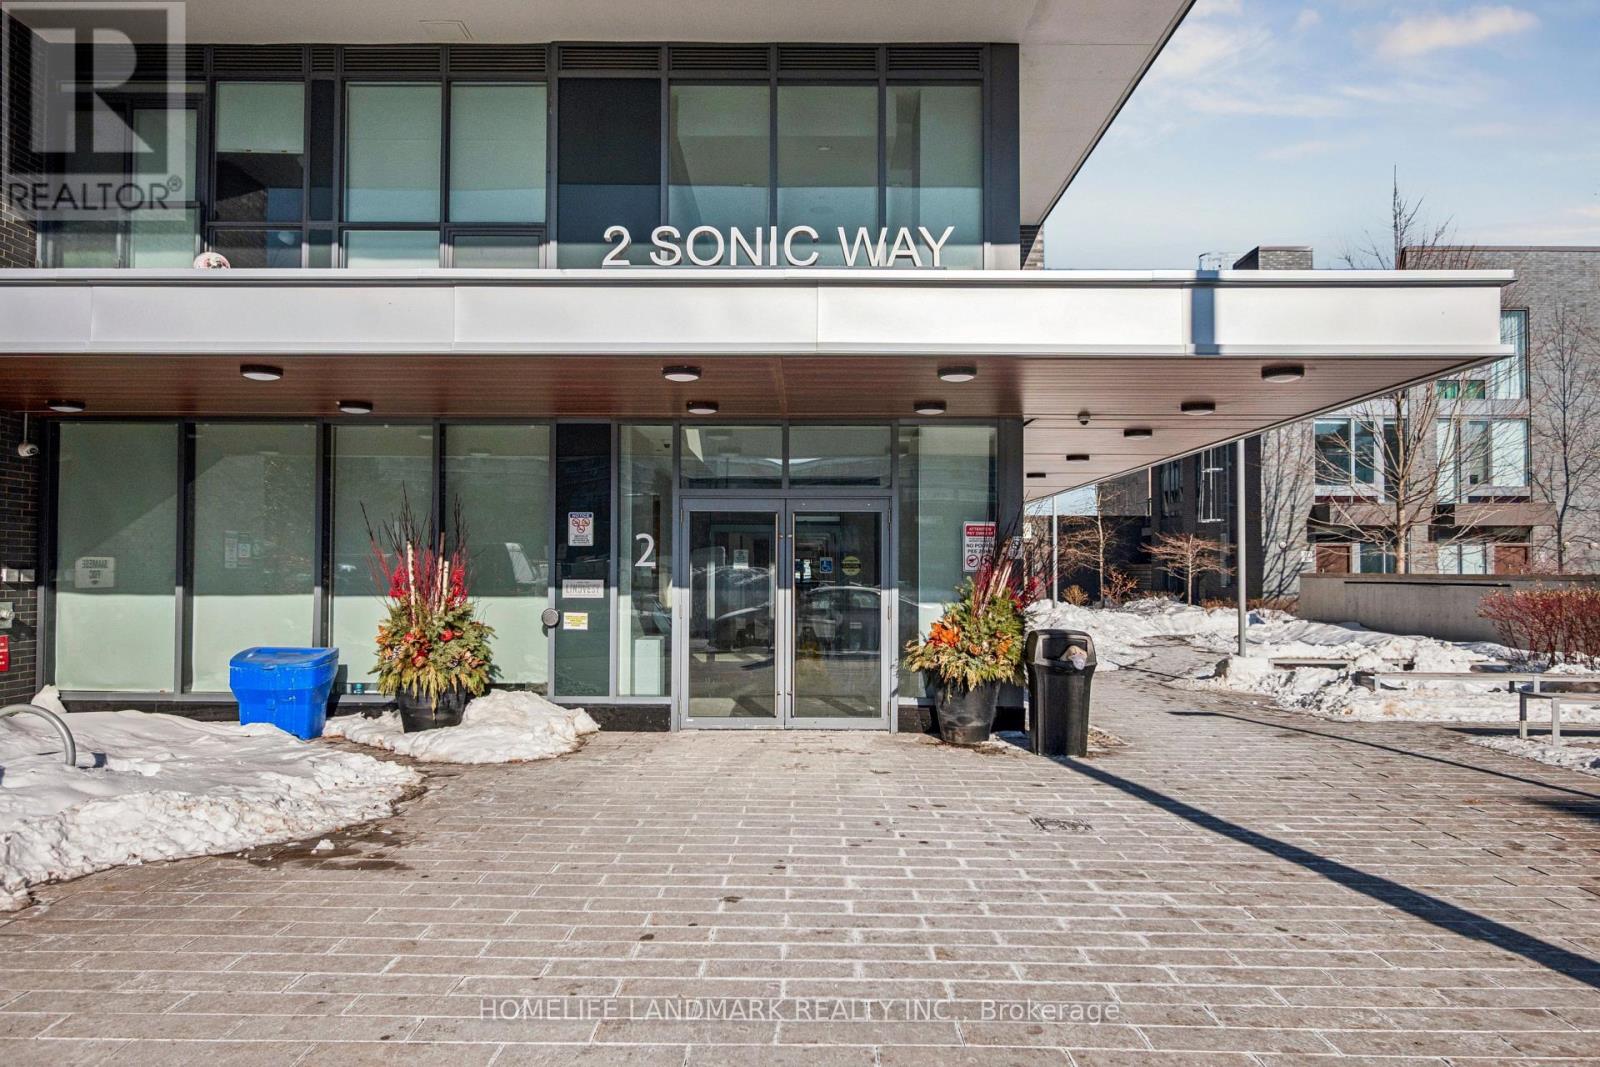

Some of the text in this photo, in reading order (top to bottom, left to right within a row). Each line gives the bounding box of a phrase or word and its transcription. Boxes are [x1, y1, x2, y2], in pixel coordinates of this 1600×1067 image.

[602, 225, 955, 267] 2 SONIC WAY
[635, 533, 656, 567] 2
